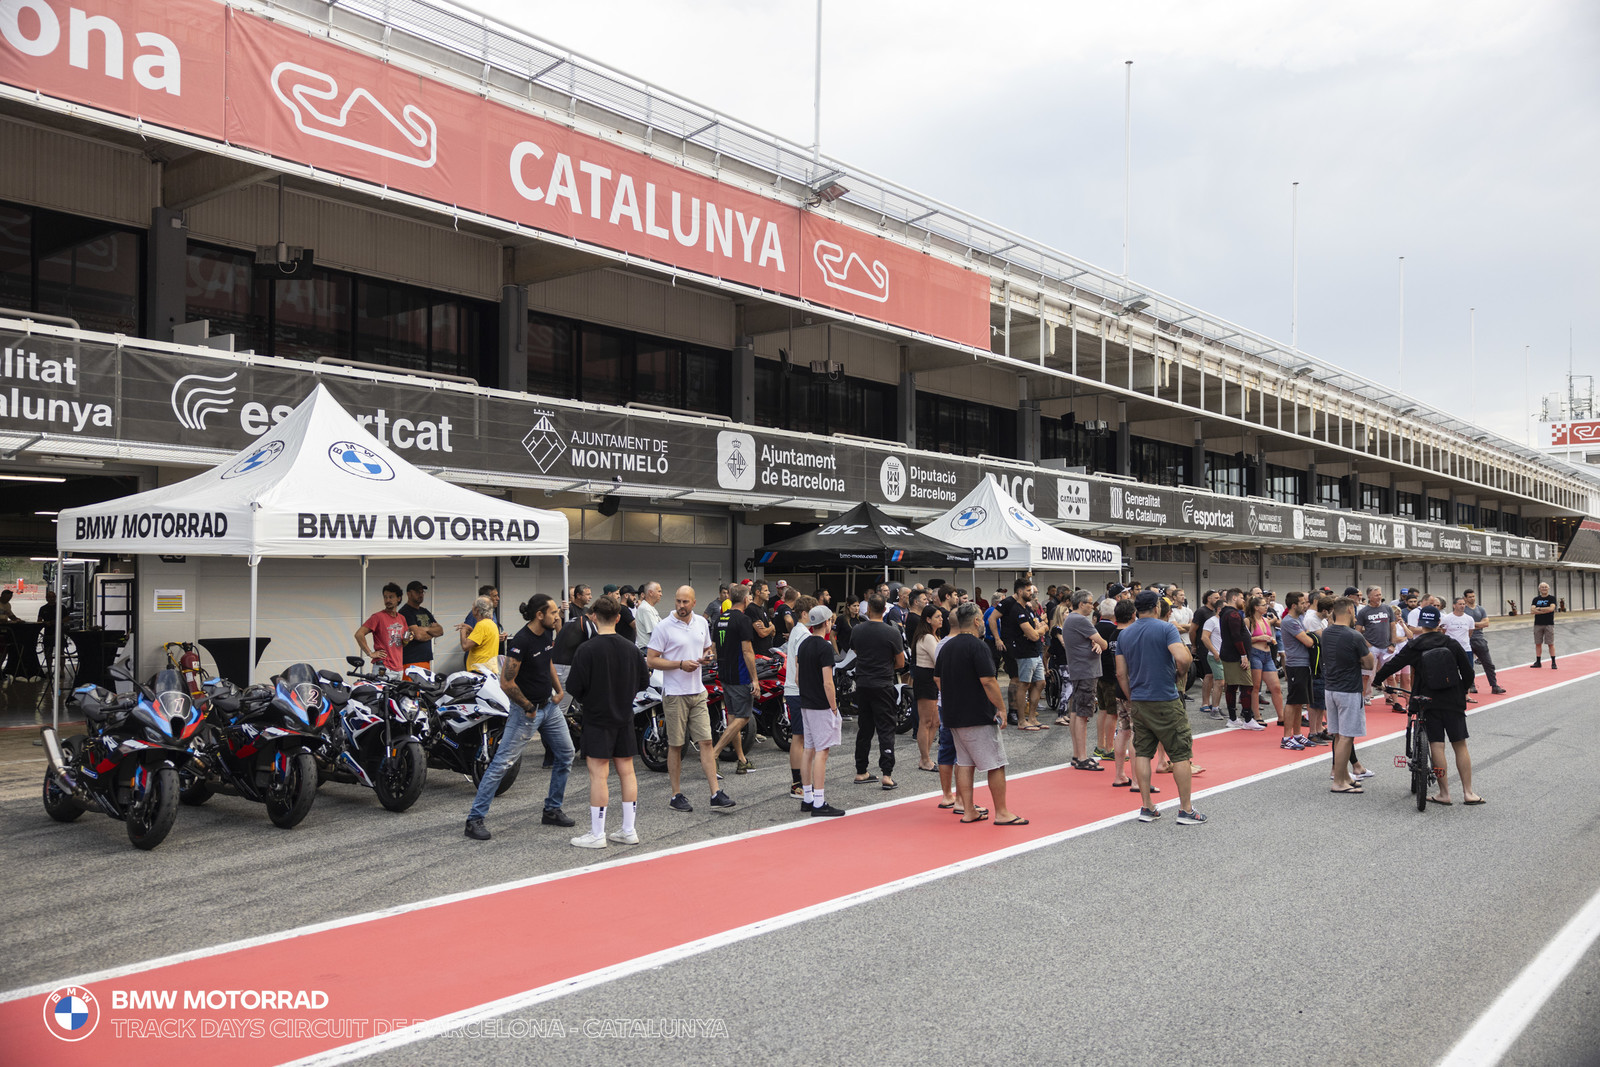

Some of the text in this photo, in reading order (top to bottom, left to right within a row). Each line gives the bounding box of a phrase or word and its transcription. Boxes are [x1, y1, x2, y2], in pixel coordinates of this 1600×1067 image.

[509, 141, 786, 273] CATALUNYA
[0, 347, 77, 385] litat
[240, 401, 453, 452] esrtcat
[570, 430, 669, 453] AJUNTAMENT DE
[571, 448, 669, 474] MONTMELÓ
[761, 444, 837, 471] Ajuntament
[761, 467, 845, 493] de Barcelona
[910, 465, 957, 485] Diputació
[910, 484, 957, 502] Barcelona
[986, 472, 1035, 513] ACC
[1060, 494, 1088, 505] CATALUNYA
[1124, 491, 1161, 508] Generalitat
[76, 512, 228, 540] BMW MOTORRAD
[298, 513, 540, 542] BMW MOTORRAD
[1125, 509, 1167, 526] de Catalunya
[1193, 508, 1234, 531] esportcat
[817, 524, 869, 536] BMC
[1368, 522, 1387, 545] RACC
[515, 556, 528, 566] 27
[1041, 546, 1113, 563] BMW MOTORRAD
[1367, 612, 1389, 621] aprilia
[174, 698, 184, 713] 1
[306, 689, 319, 704] 2
